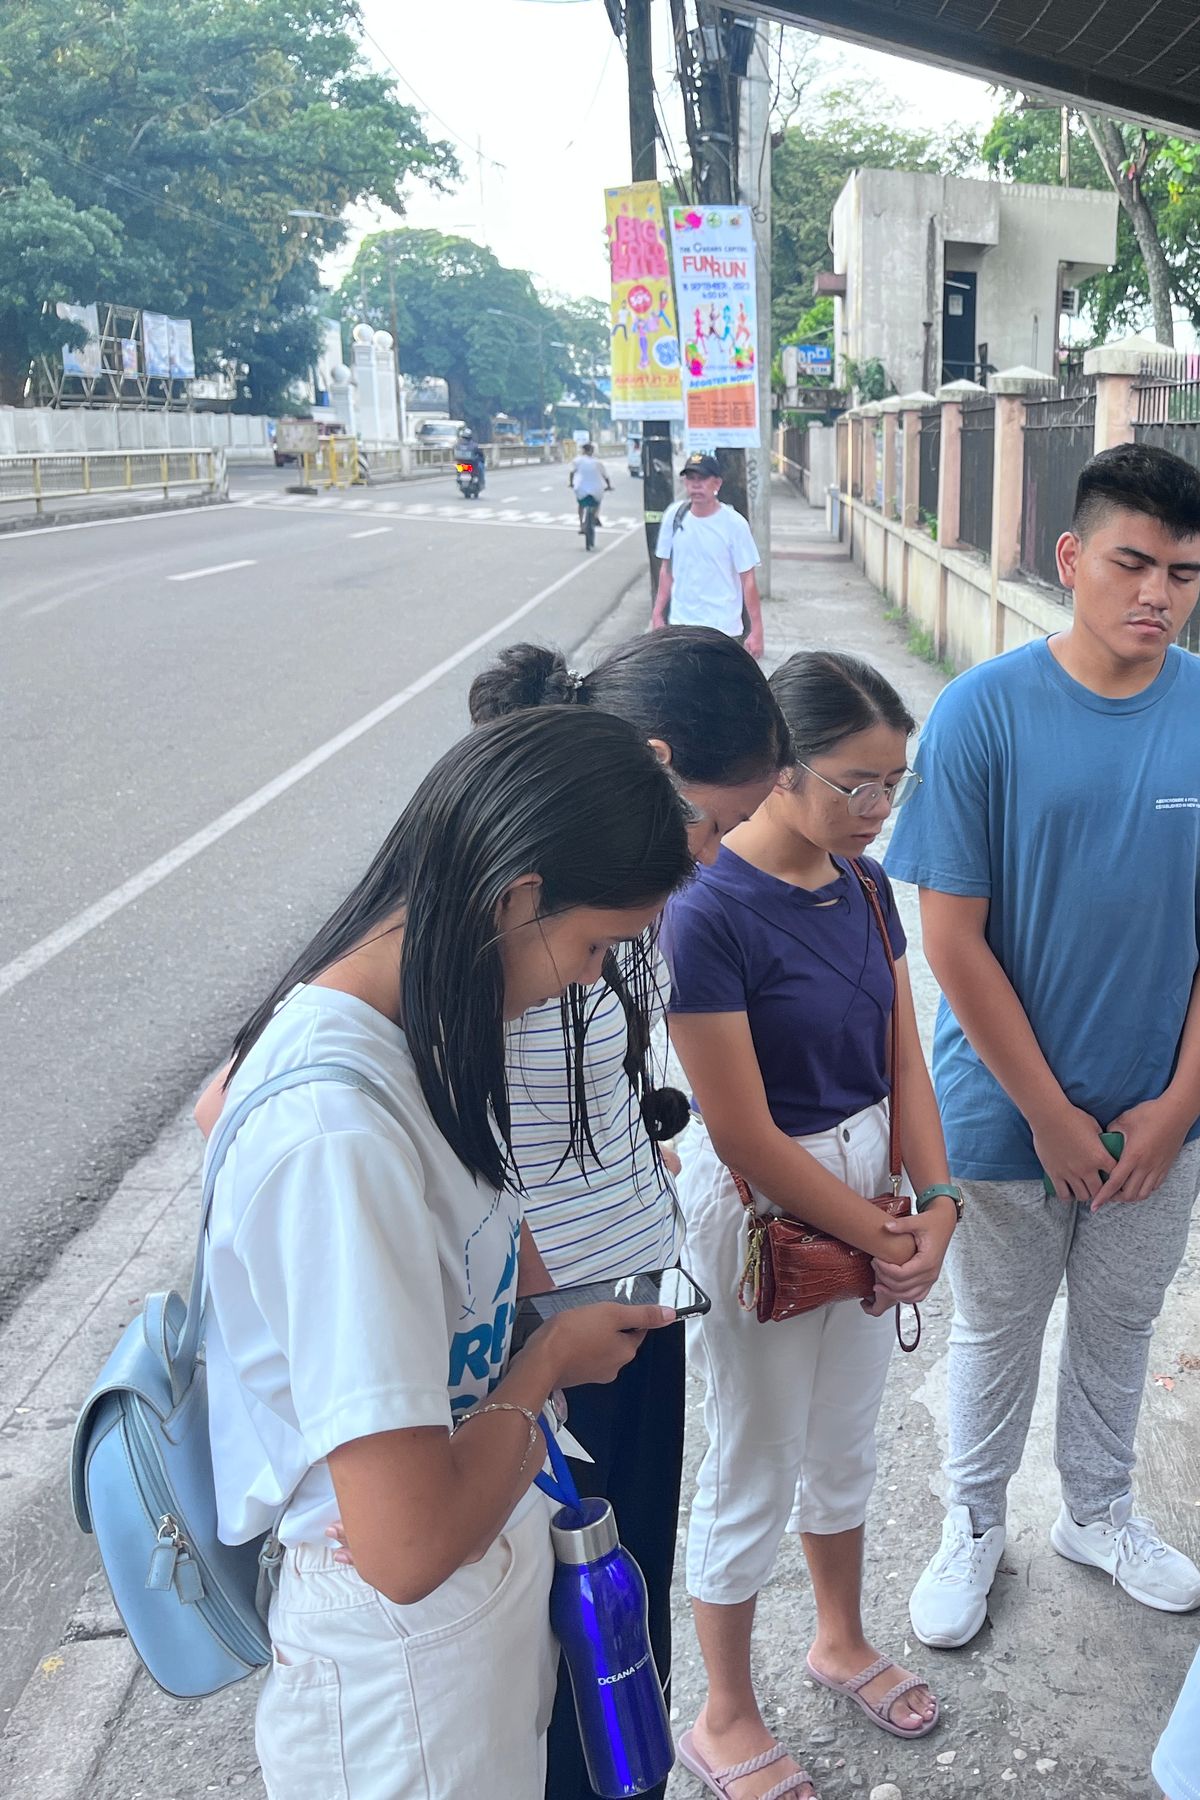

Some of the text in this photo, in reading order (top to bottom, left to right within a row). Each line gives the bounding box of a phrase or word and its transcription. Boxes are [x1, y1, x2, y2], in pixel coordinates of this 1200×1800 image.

[615, 215, 658, 243] BIG
[682, 255, 746, 278] FUN RUN
[598, 1666, 635, 1686] OCEANA
